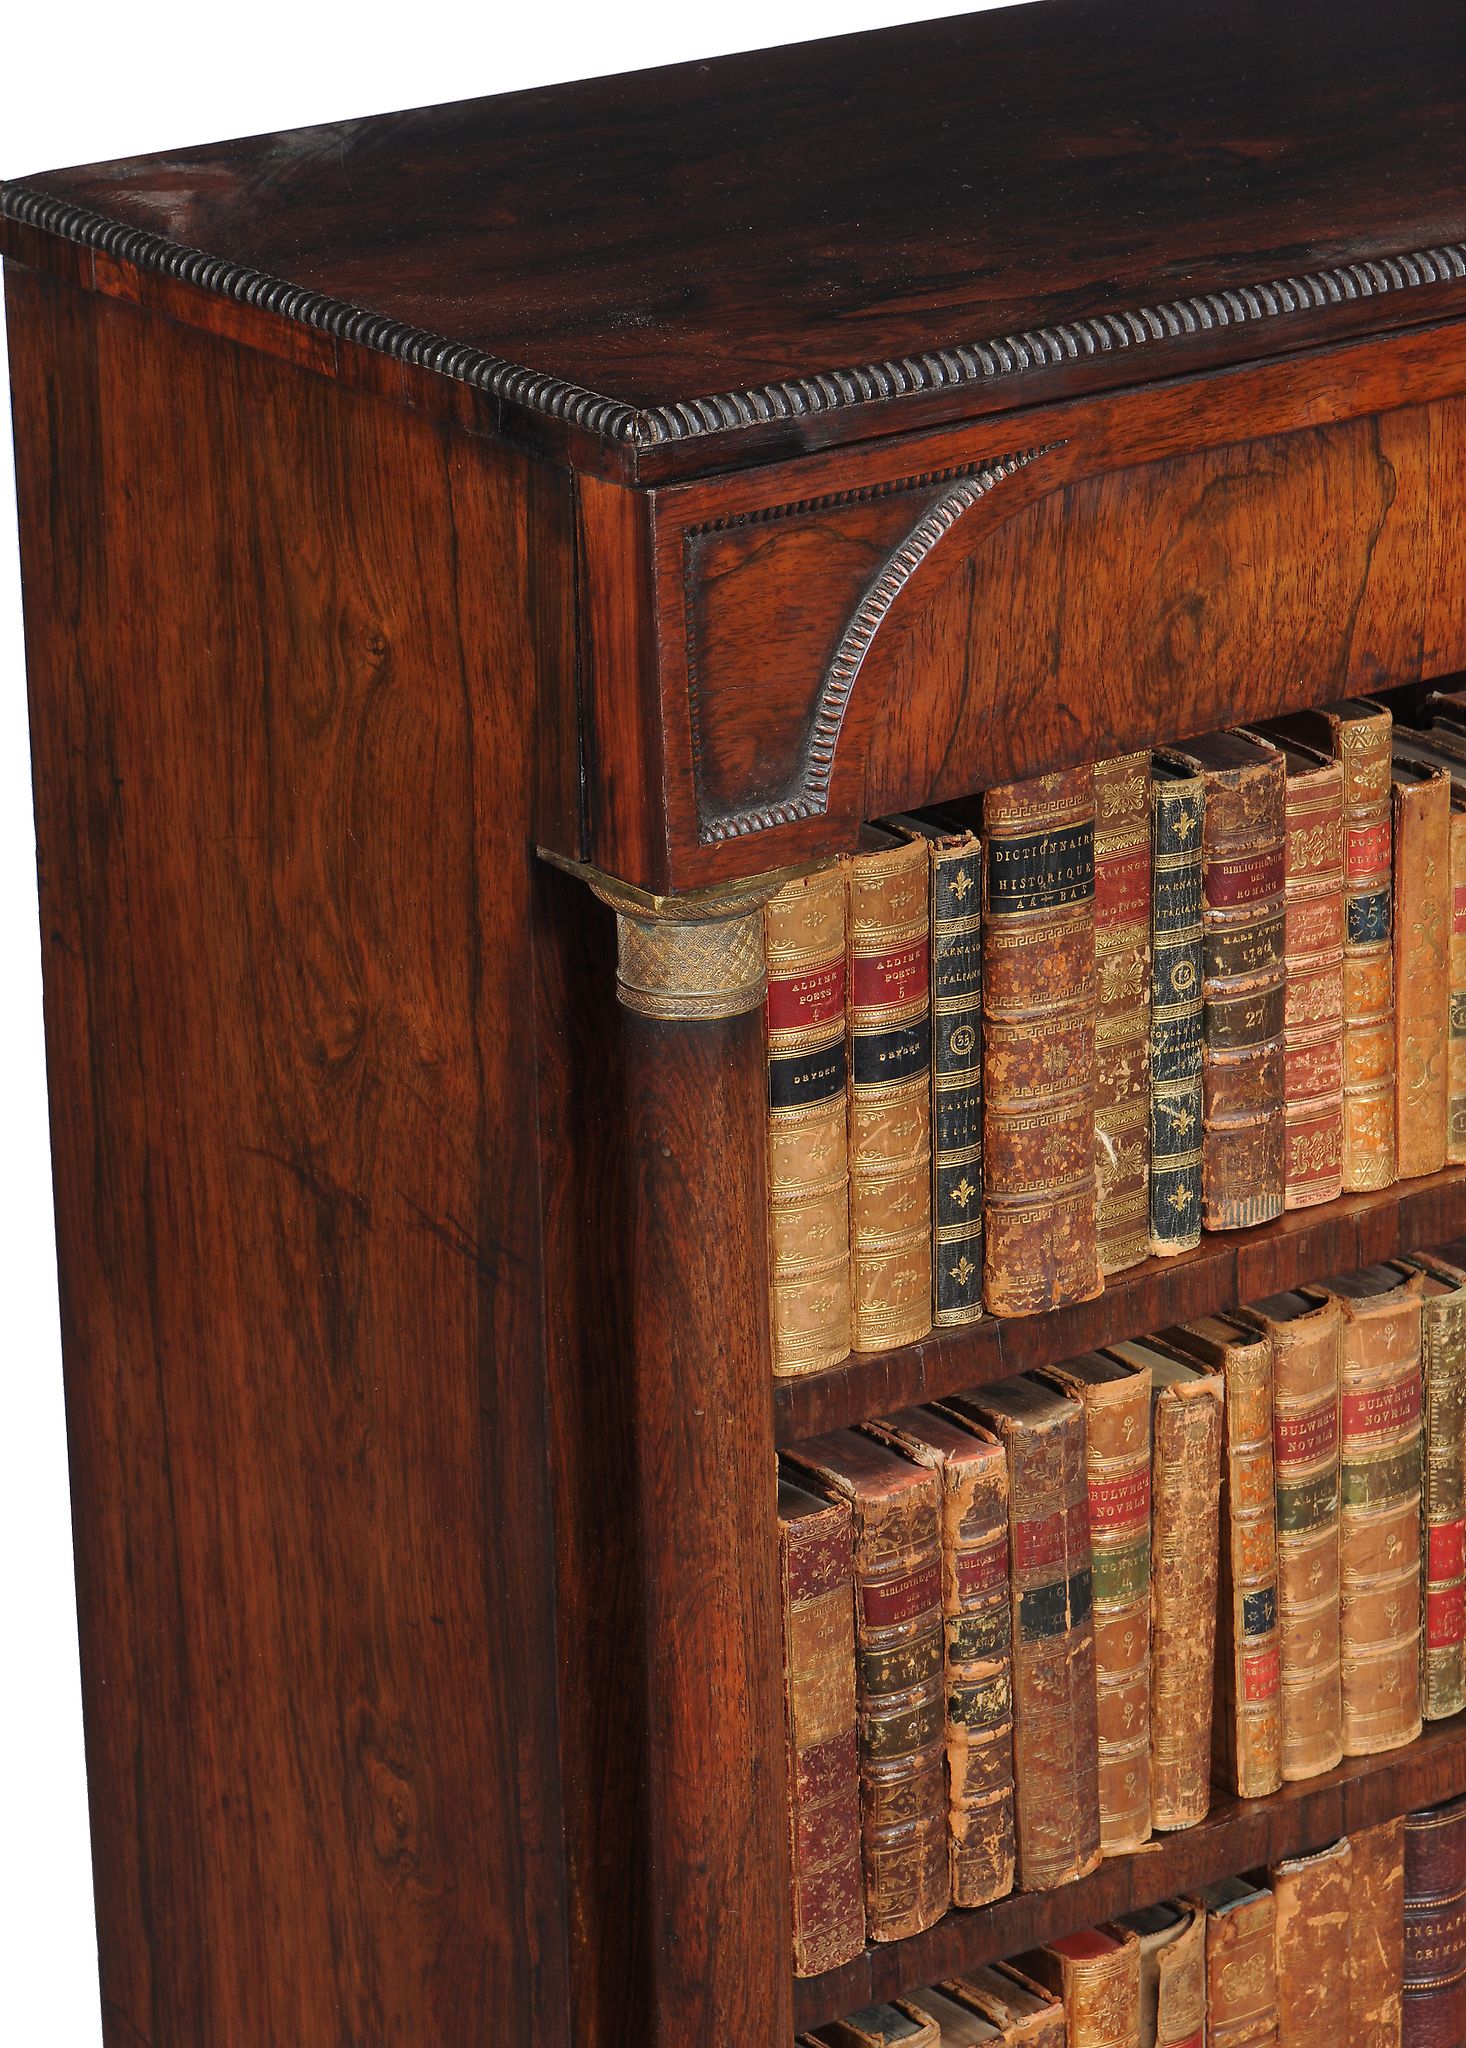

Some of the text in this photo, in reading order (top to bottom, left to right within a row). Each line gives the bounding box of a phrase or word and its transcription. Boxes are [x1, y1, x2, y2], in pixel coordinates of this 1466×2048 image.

[999, 862, 1091, 890] HISTORIQUE
[1236, 880, 1278, 899] ROMANS
[1366, 905, 1379, 929] 5
[791, 971, 838, 993] ALDINE
[898, 986, 906, 1000] 5
[799, 988, 833, 1005] POETS
[1245, 1010, 1264, 1028] 27
[956, 1033, 971, 1047] 35
[793, 1065, 837, 1085] DRYDEN
[1357, 1386, 1415, 1412] BULWER'S
[1280, 1411, 1336, 1436] BULWER'S
[1364, 1404, 1411, 1426] NOVELS
[1287, 1428, 1334, 1453] NOVELS
[1090, 1477, 1149, 1501] BULWER'S
[1096, 1495, 1146, 1518] NOVELS
[879, 1568, 937, 1598] BIBLIOTHEQUE
